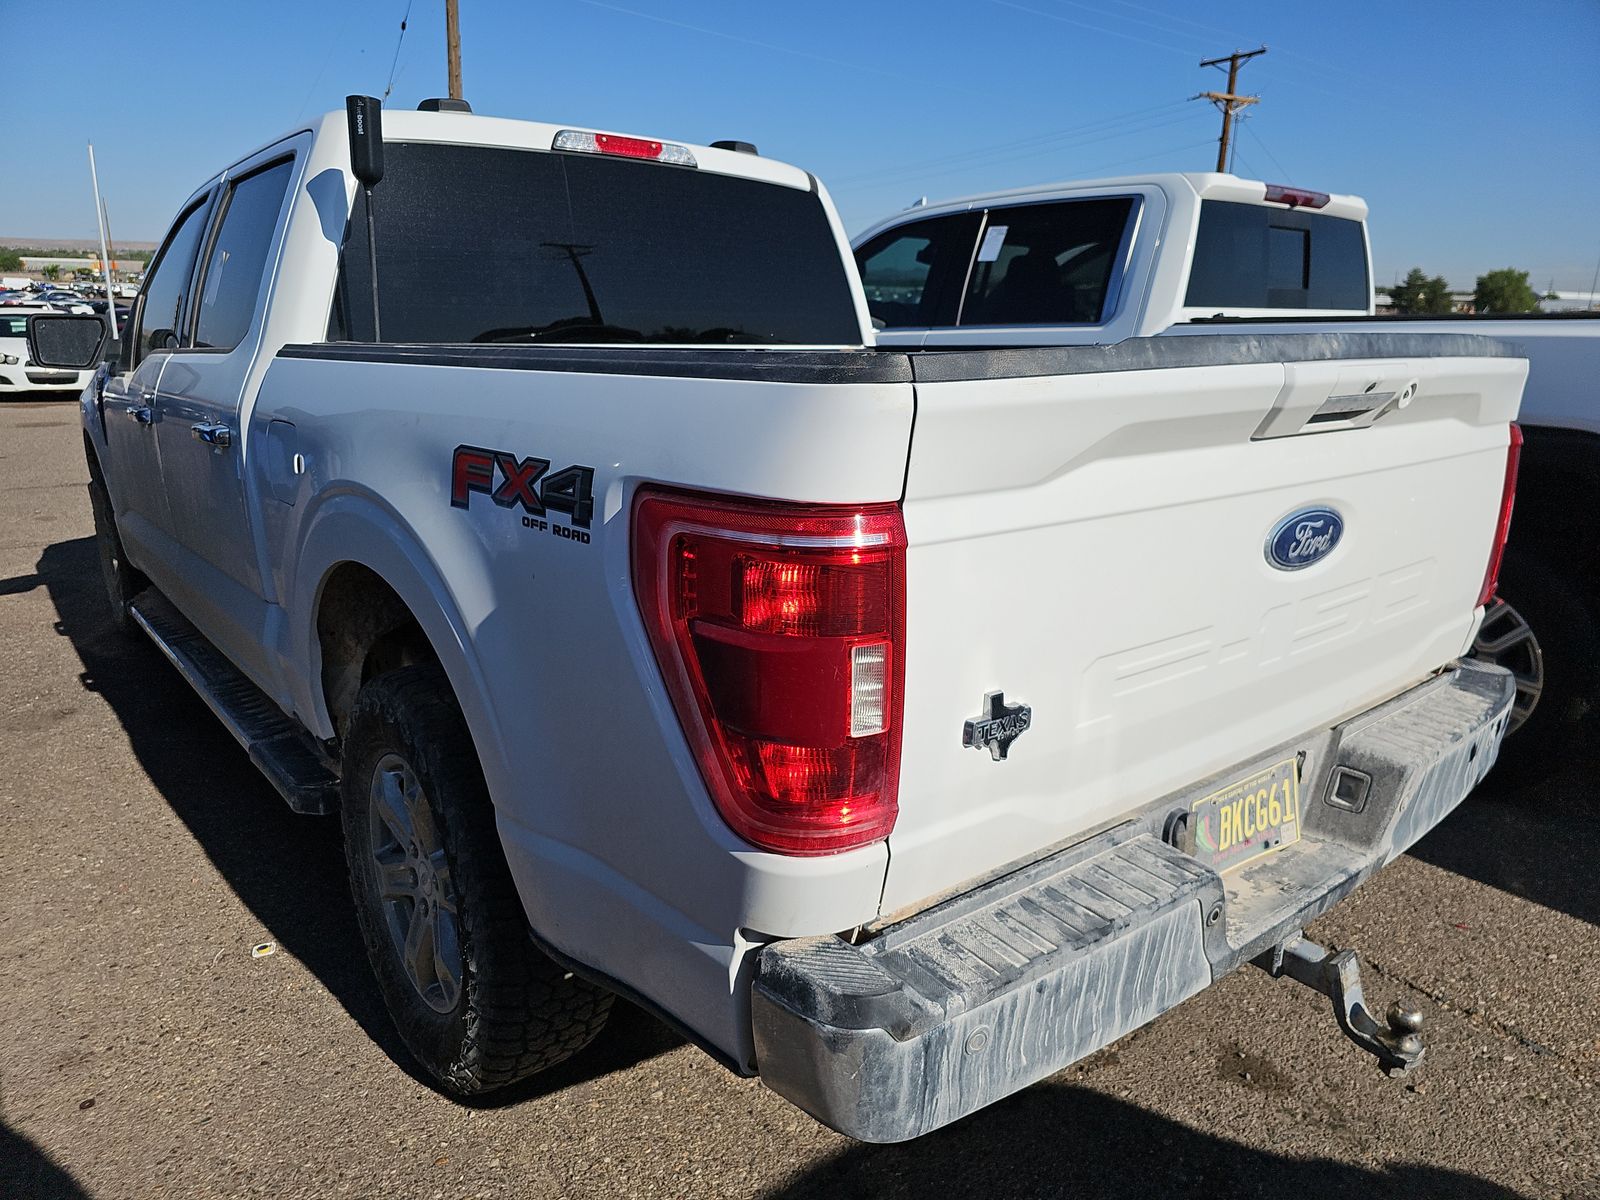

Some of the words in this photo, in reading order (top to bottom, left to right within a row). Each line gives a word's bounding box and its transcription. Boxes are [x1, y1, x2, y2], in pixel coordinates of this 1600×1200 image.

[451, 444, 595, 529] FX4
[522, 516, 548, 532] OFF
[552, 523, 591, 545] ROAD
[1288, 520, 1333, 559] Ford
[977, 713, 1030, 742] TEXAS
[1218, 778, 1295, 850] BKCG61
